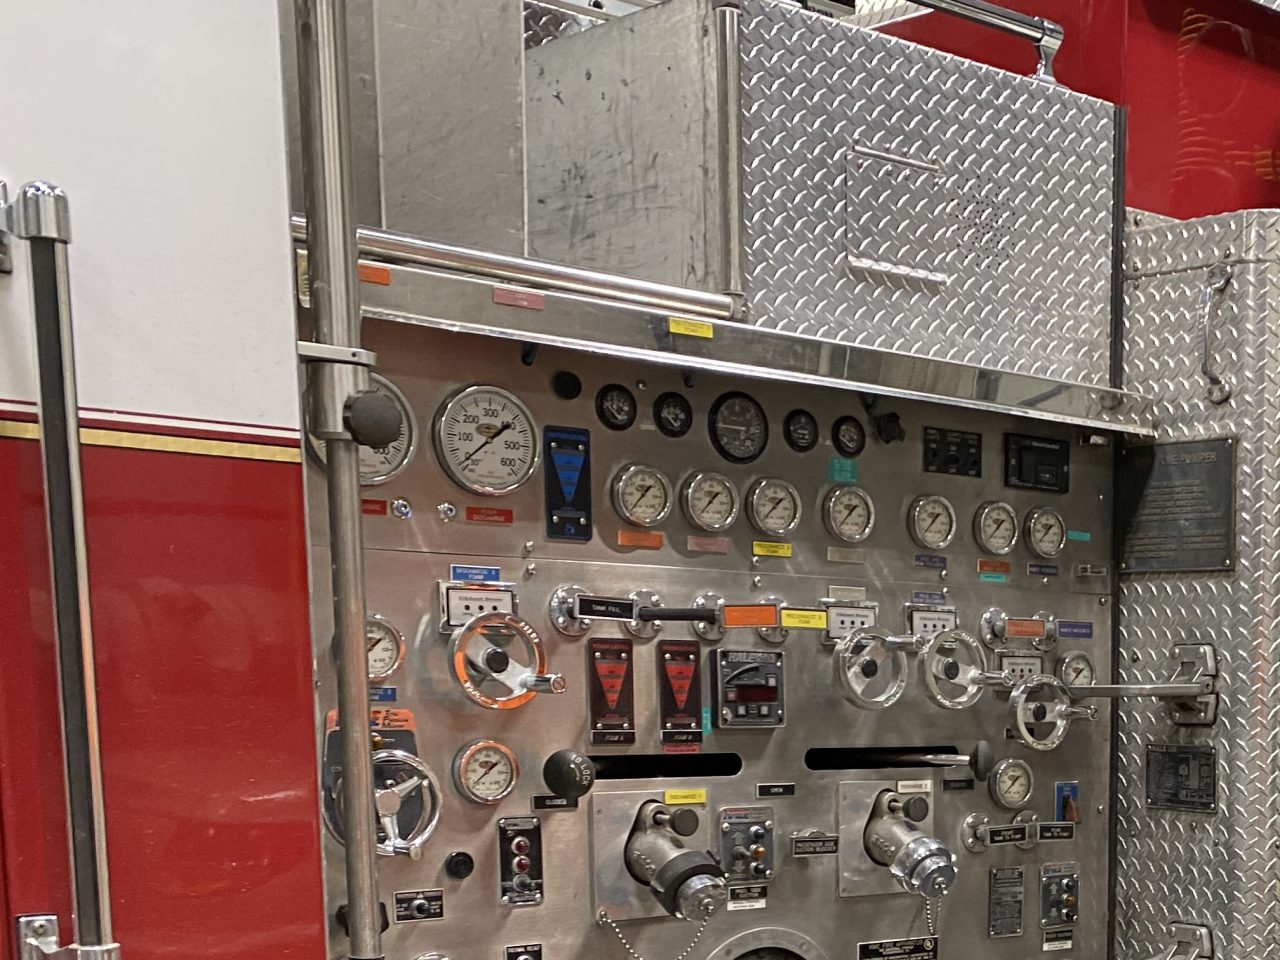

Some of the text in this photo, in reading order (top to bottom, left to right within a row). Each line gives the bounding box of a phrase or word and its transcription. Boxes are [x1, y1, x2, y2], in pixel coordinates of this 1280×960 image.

[482, 408, 499, 418] 300
[463, 414, 479, 425] 200
[457, 433, 473, 442] 100
[504, 441, 520, 450] 500
[500, 458, 516, 467] 600
[580, 762, 592, 785] LOCK
